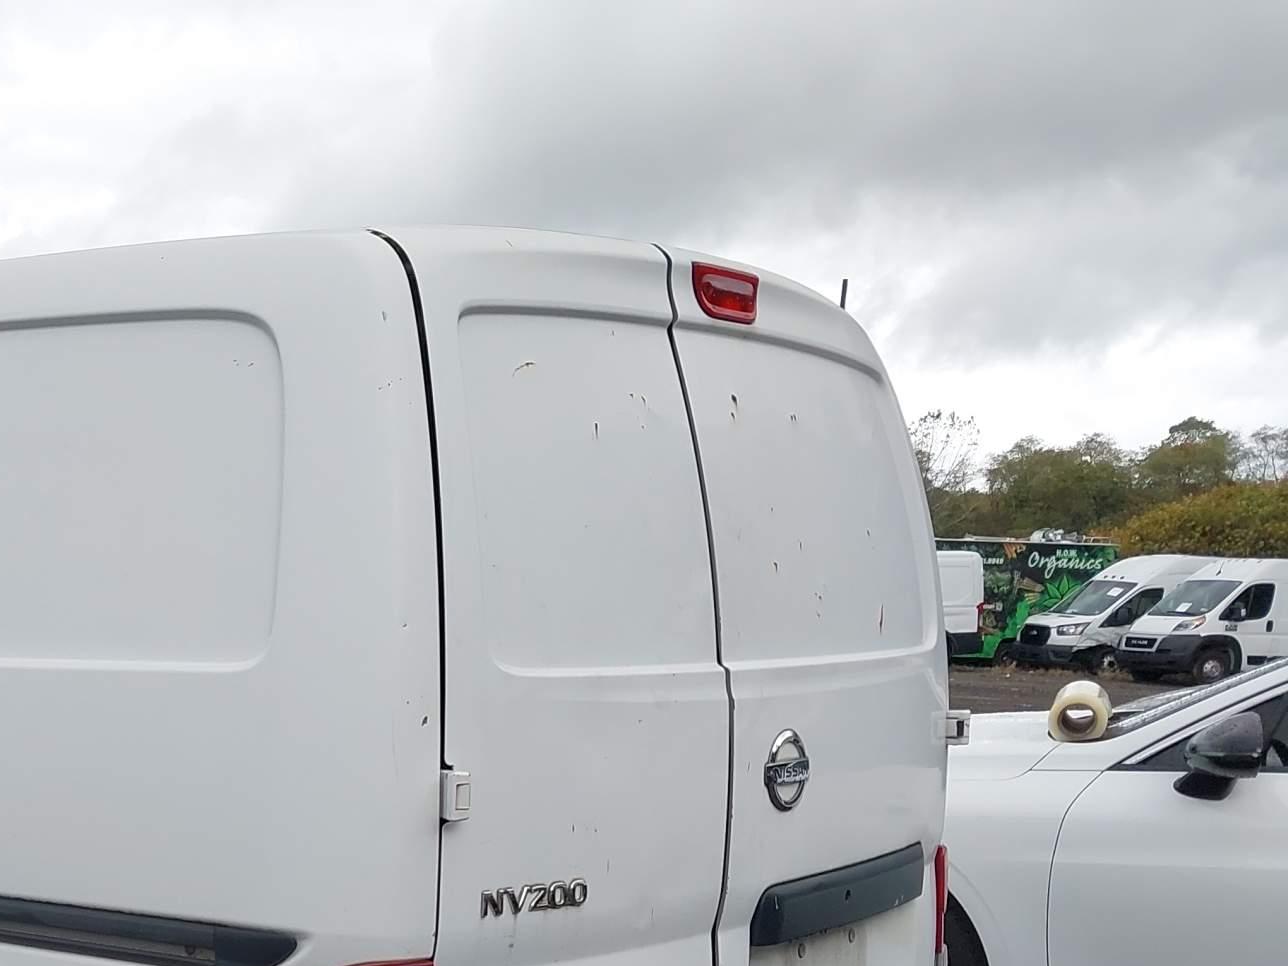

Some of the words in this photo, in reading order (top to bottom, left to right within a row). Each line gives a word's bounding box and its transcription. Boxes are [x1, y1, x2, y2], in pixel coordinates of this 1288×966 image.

[1028, 551, 1103, 579] Organics
[774, 766, 809, 783] NISSAN
[480, 878, 588, 919] NV200
